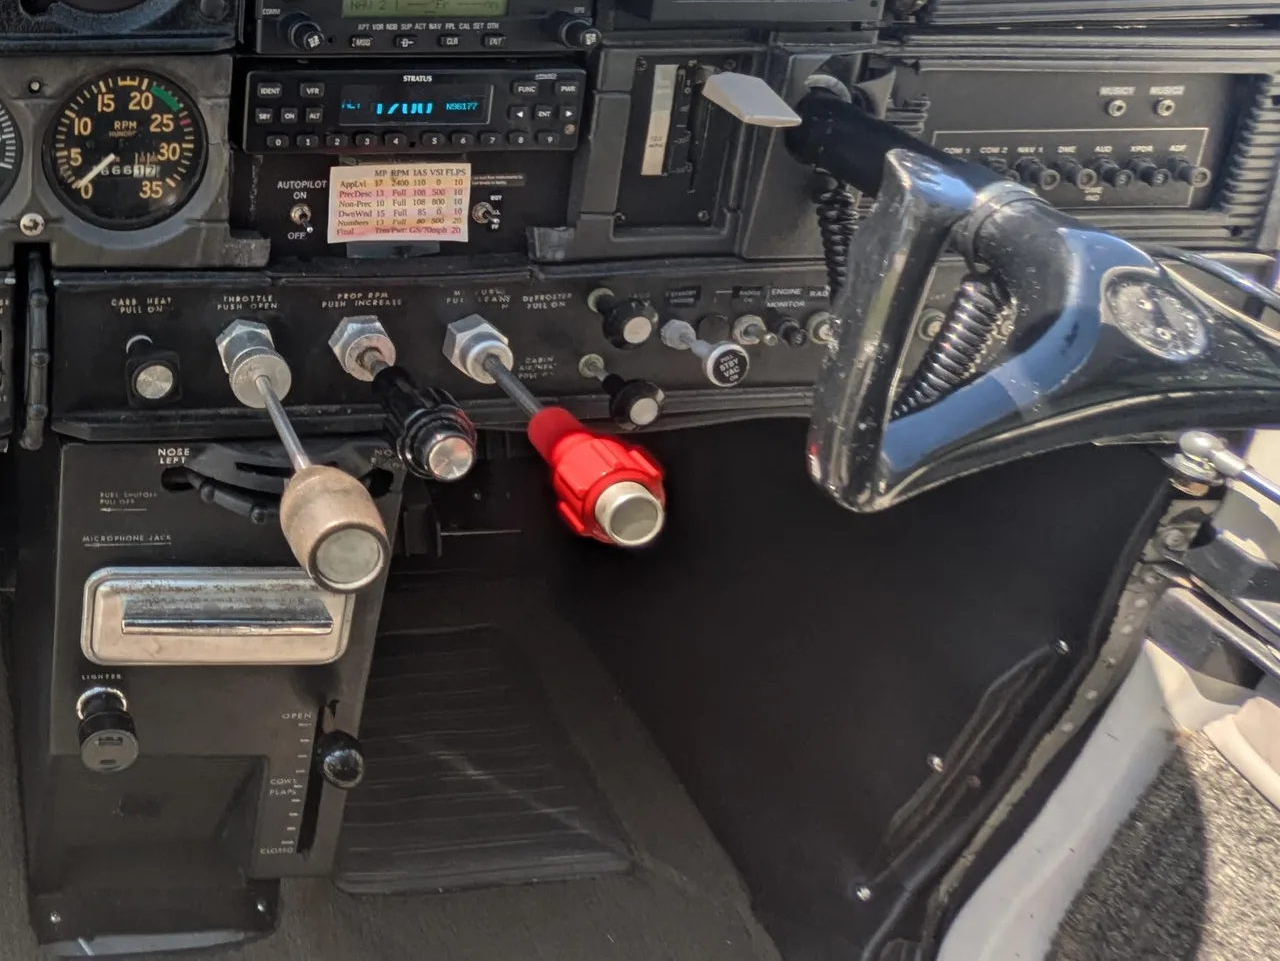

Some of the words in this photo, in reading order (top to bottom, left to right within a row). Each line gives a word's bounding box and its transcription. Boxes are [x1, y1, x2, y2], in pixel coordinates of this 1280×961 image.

[98, 94, 115, 112] 15
[128, 92, 153, 110] 20
[446, 102, 478, 111] N96177
[74, 117, 92, 135] 10
[114, 121, 137, 130] RPM
[150, 114, 174, 132] 25
[158, 143, 180, 160] 30
[70, 148, 82, 166] 5
[374, 169, 387, 177] MP
[390, 169, 410, 177] RPM
[413, 168, 428, 176] IAS
[430, 168, 444, 176] VSI
[445, 168, 466, 176] FLPS
[277, 180, 327, 189] AUTOPILOT
[140, 181, 163, 199] 35
[339, 199, 372, 208] Non-Prec
[392, 199, 407, 207] Full
[338, 209, 372, 217] DwnWnd
[337, 218, 369, 226] Numbers
[288, 231, 305, 240] OFF
[336, 227, 354, 235] Final
[771, 288, 802, 296] ENGINE
[158, 448, 190, 456] NOSE
